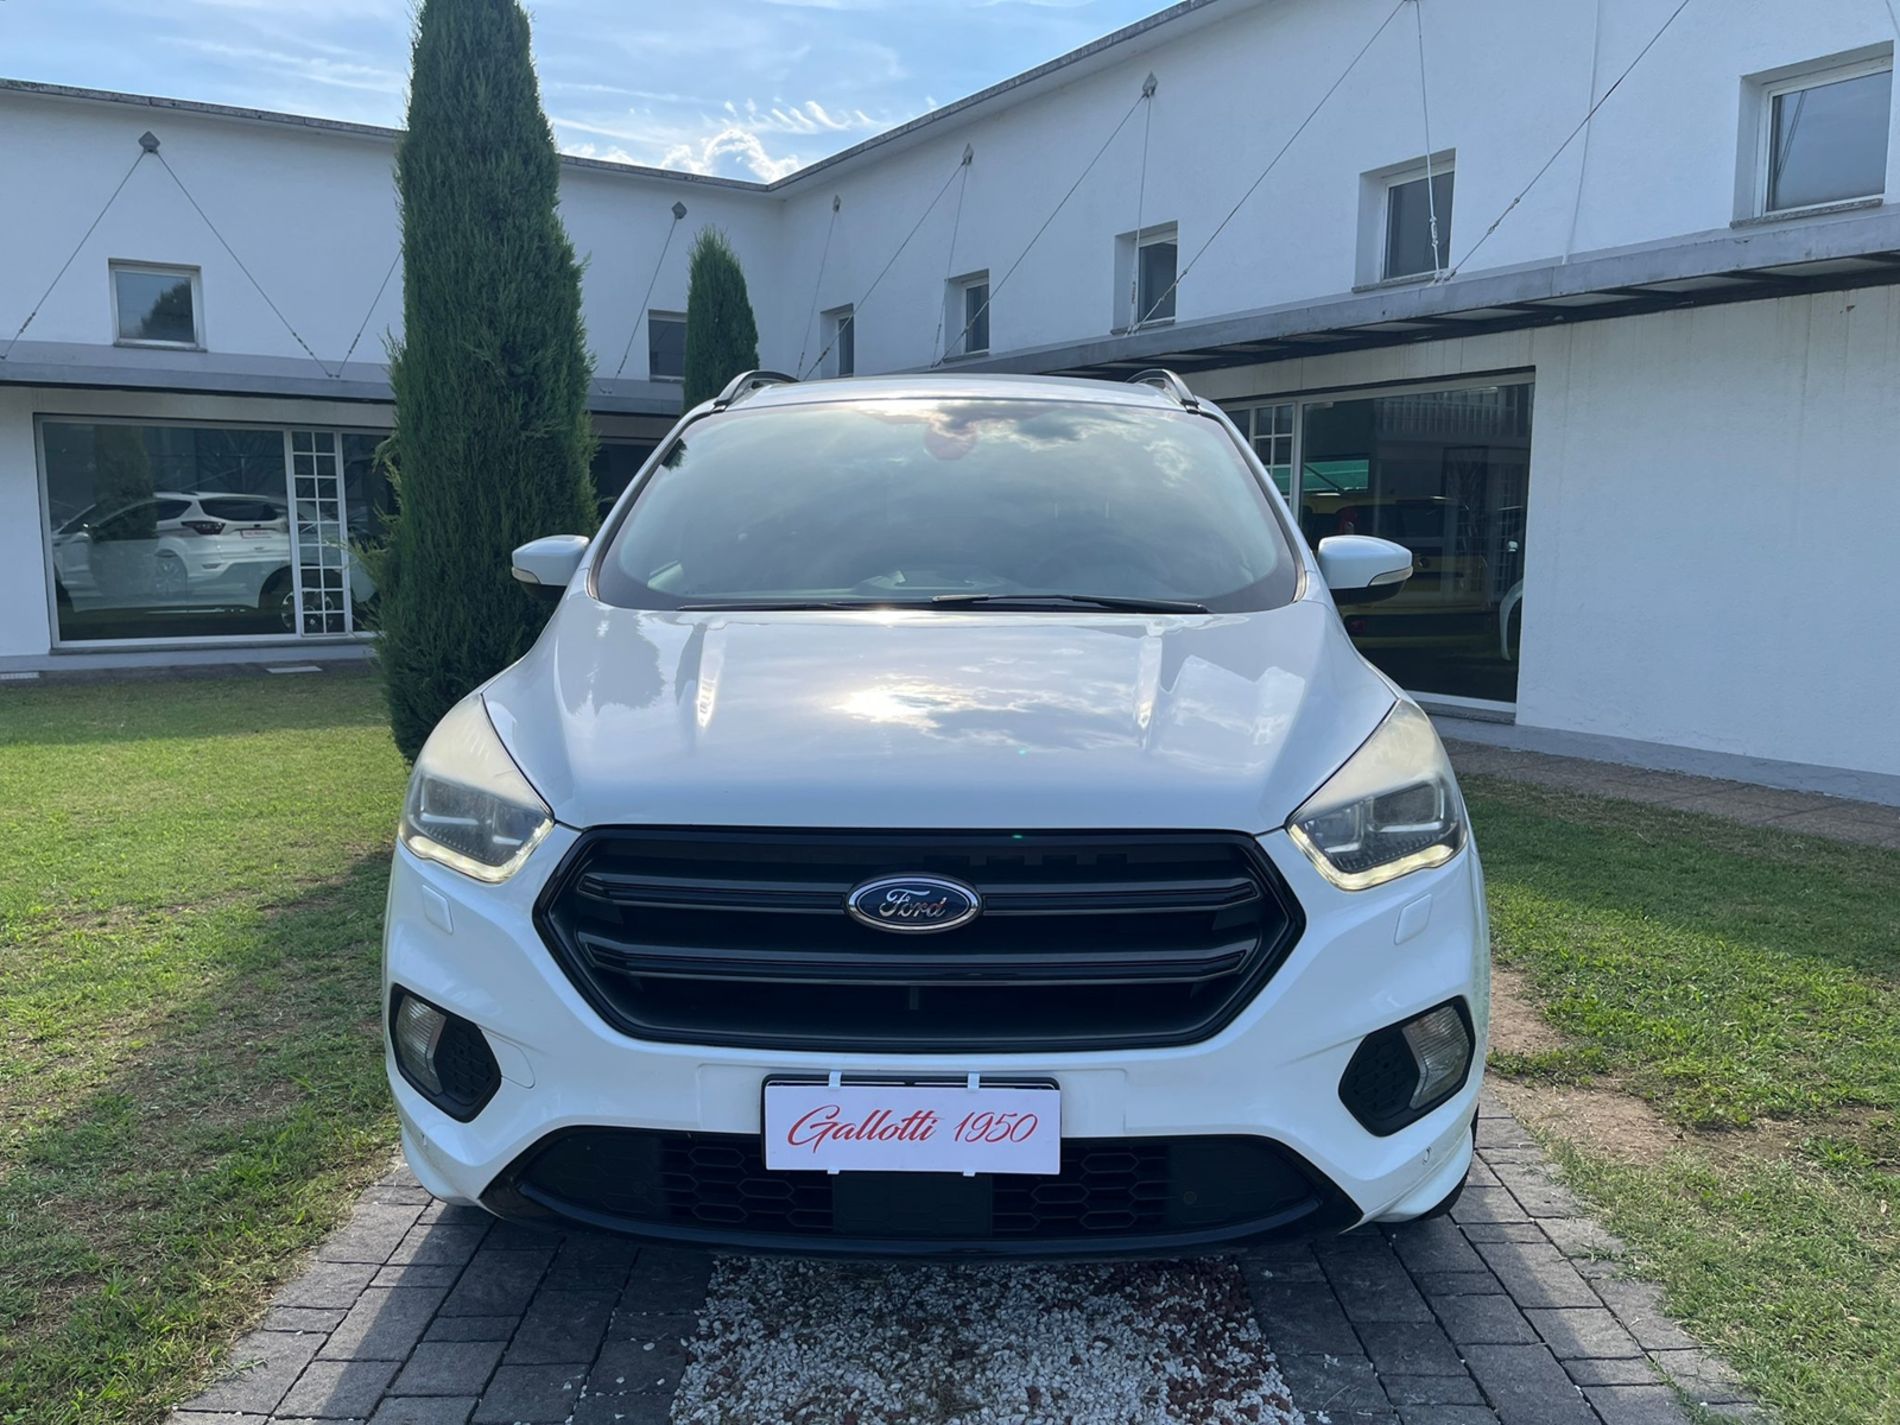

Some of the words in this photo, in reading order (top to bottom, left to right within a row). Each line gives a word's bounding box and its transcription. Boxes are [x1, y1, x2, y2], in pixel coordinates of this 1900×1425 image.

[879, 888, 947, 917] Ford
[787, 1104, 945, 1153] Gallotti
[954, 1111, 1038, 1143] 1950
